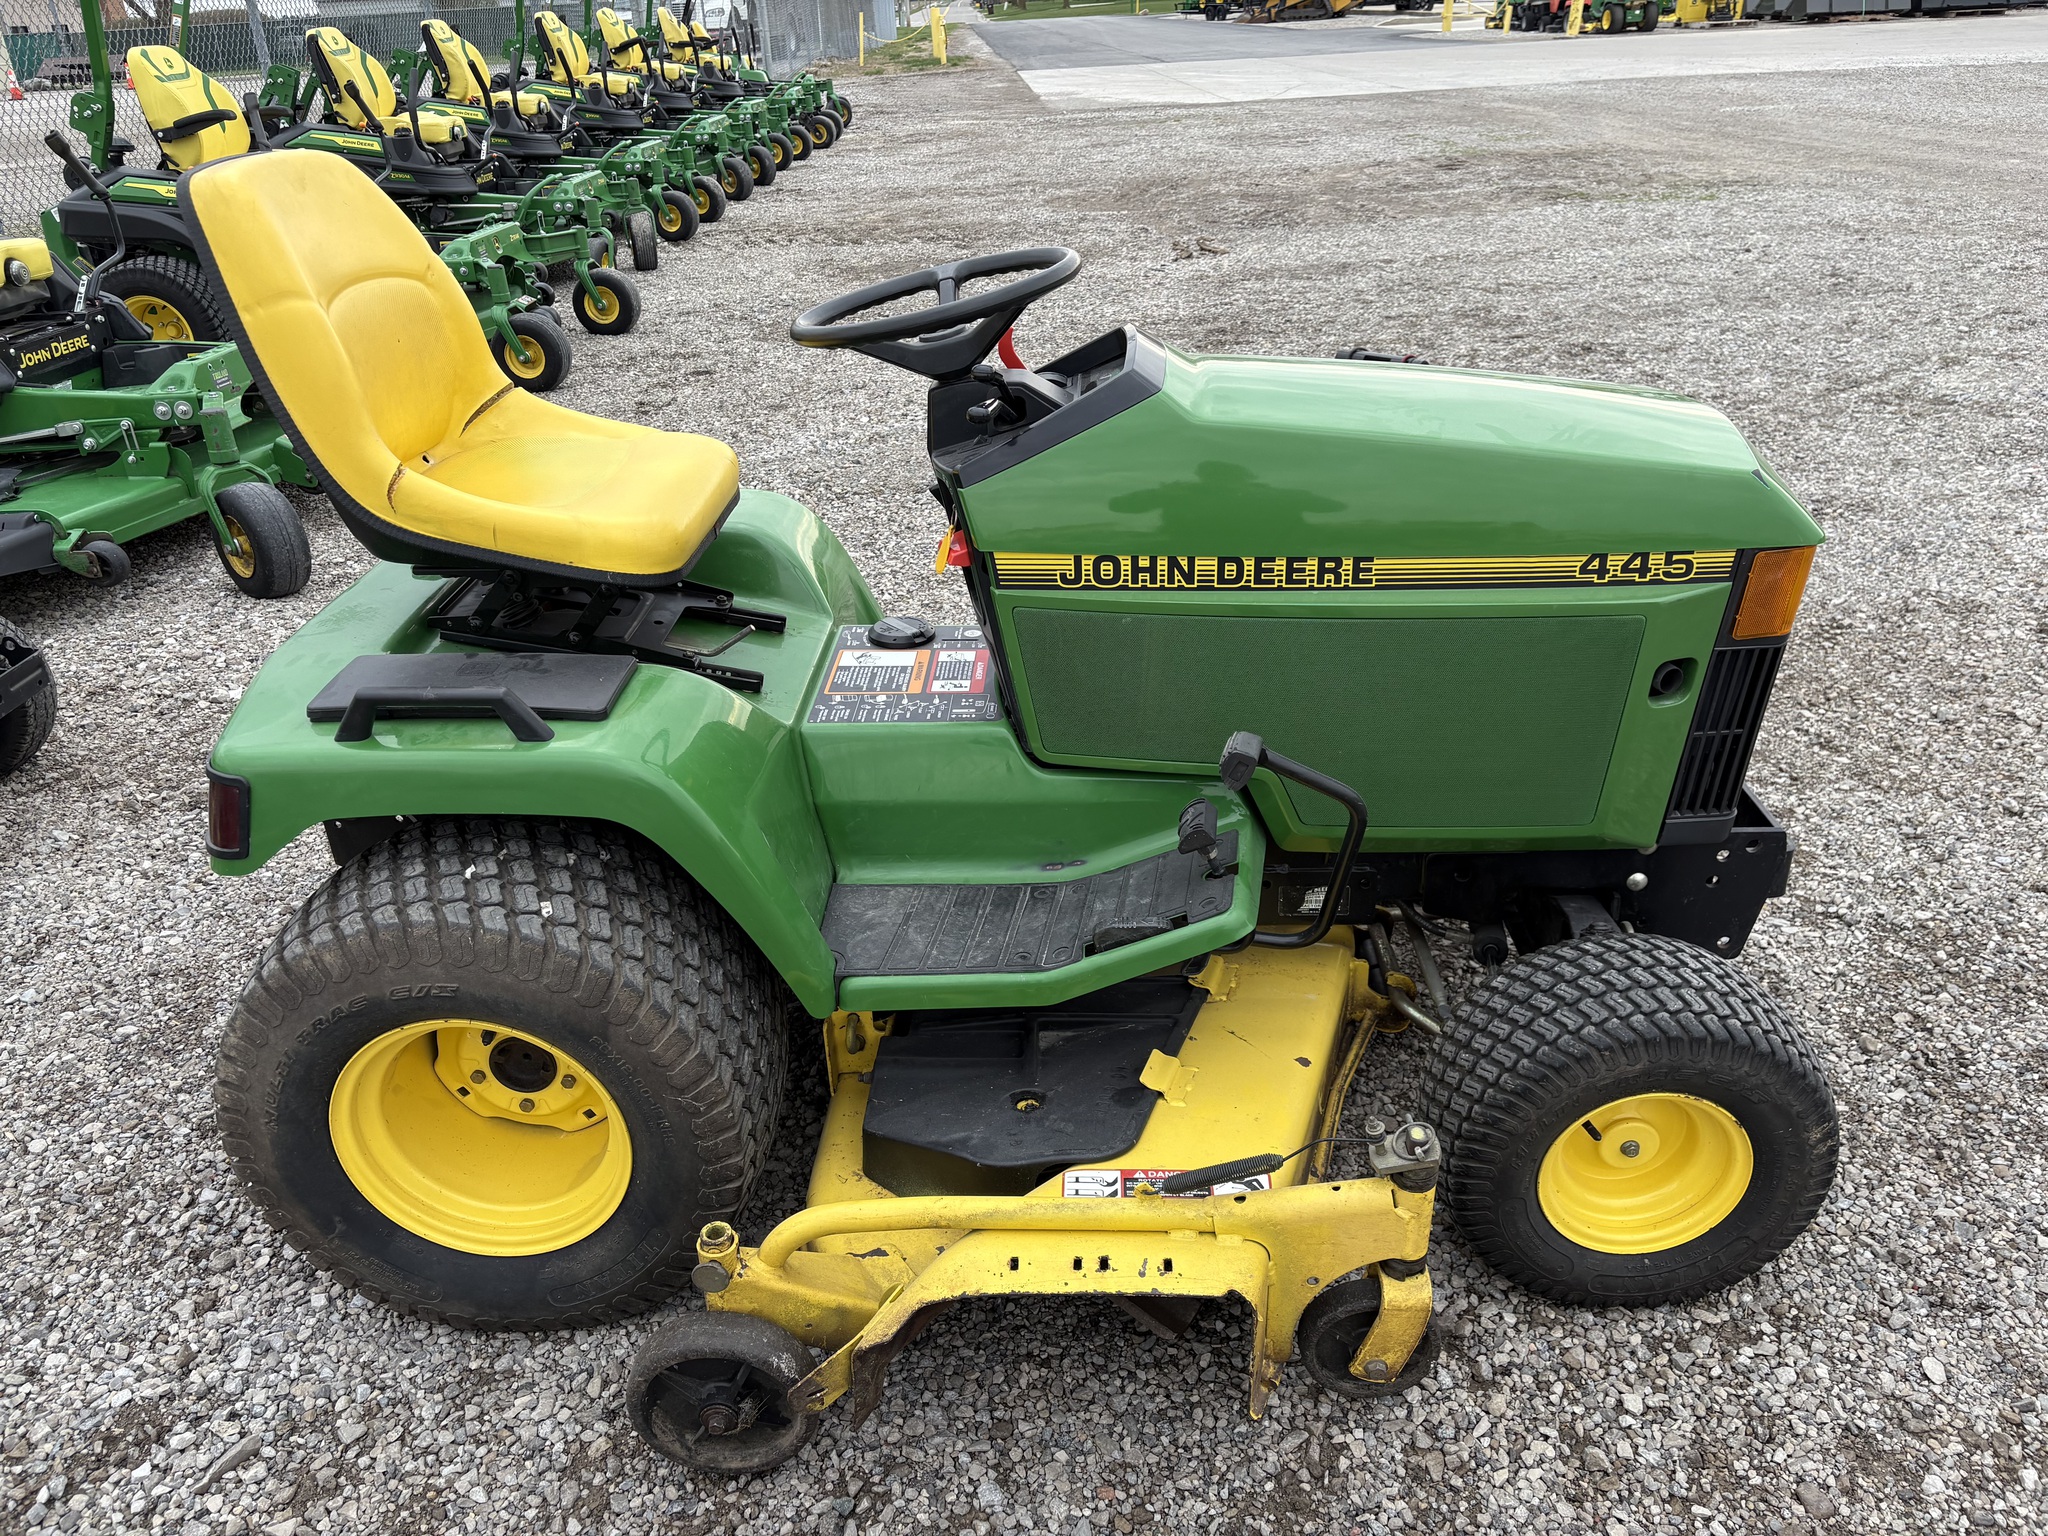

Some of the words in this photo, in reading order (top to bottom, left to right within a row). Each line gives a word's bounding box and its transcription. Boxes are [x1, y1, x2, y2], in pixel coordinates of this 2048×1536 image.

[20, 348, 51, 369] JOHN
[50, 334, 90, 358] DEERE
[1057, 554, 1197, 588] JOHN
[1215, 556, 1376, 588] DEERE
[1576, 550, 1696, 583] 445
[914, 665, 924, 681] WARNING
[574, 1241, 658, 1300] TITAN
